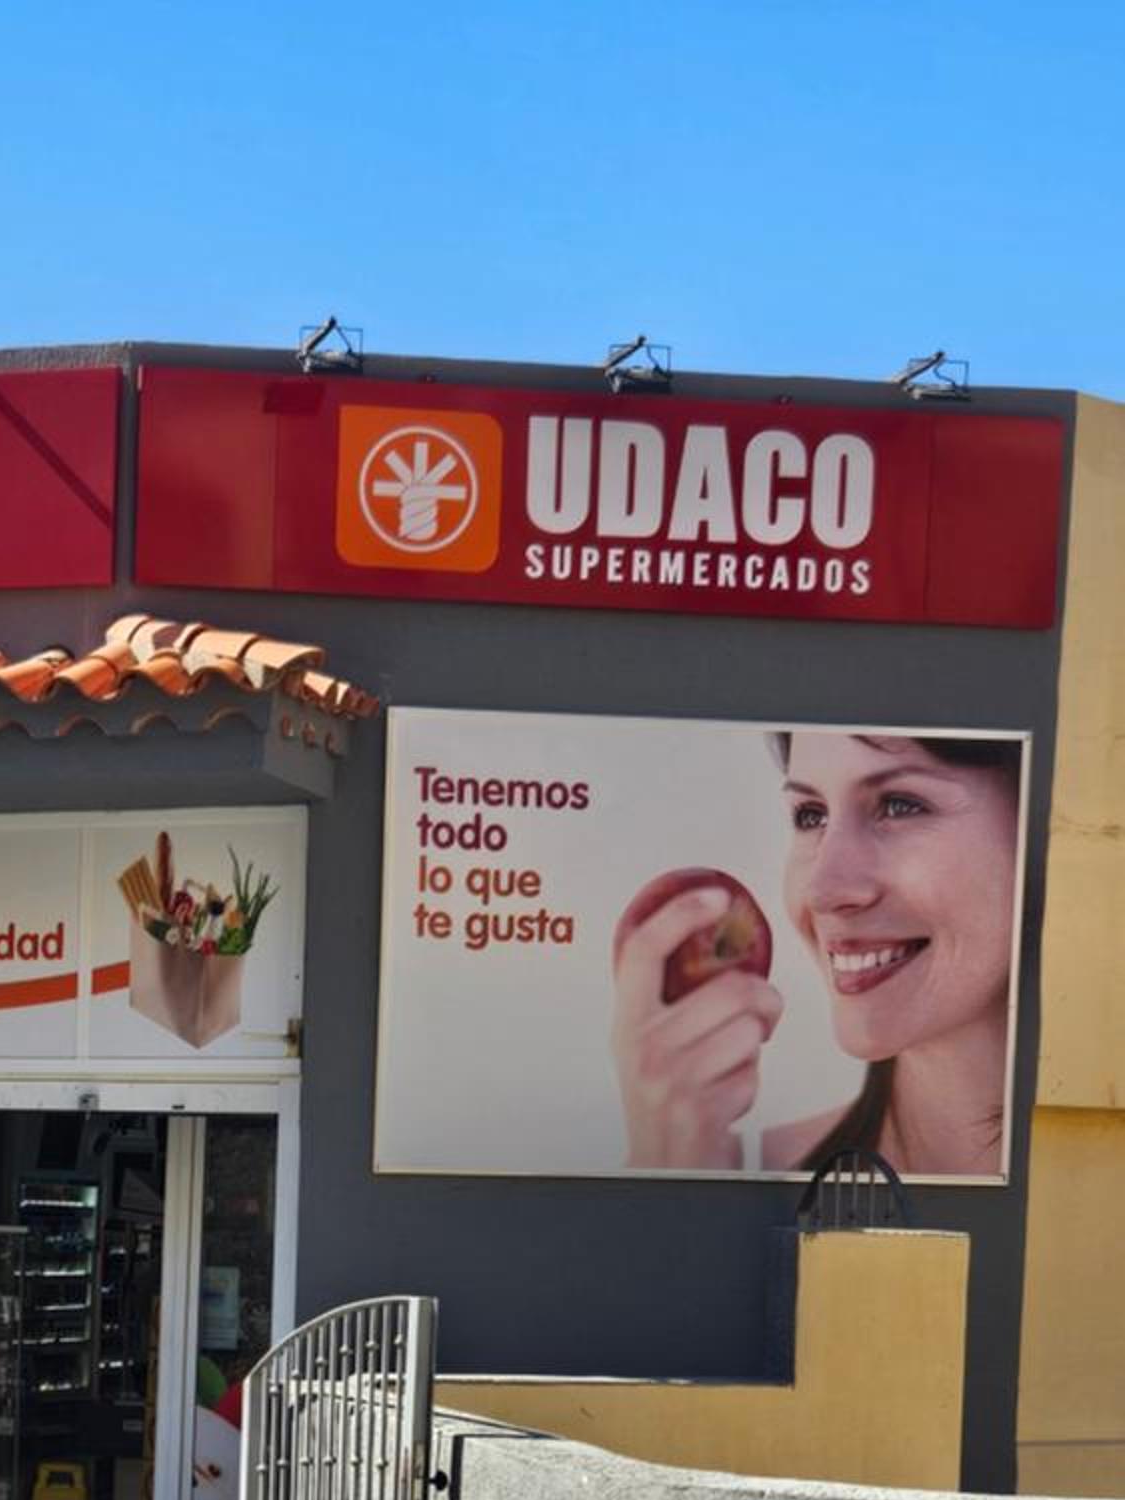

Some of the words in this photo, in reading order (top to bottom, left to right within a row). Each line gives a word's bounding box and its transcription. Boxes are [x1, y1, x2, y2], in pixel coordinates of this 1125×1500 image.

[527, 415, 876, 550] UDACO
[525, 544, 871, 596] SUPERMERCADOS
[414, 766, 590, 810] Tenemos
[416, 812, 508, 852] todo
[417, 855, 453, 894] lo
[465, 866, 541, 906] que
[414, 902, 453, 937] te
[465, 909, 574, 951] gusta
